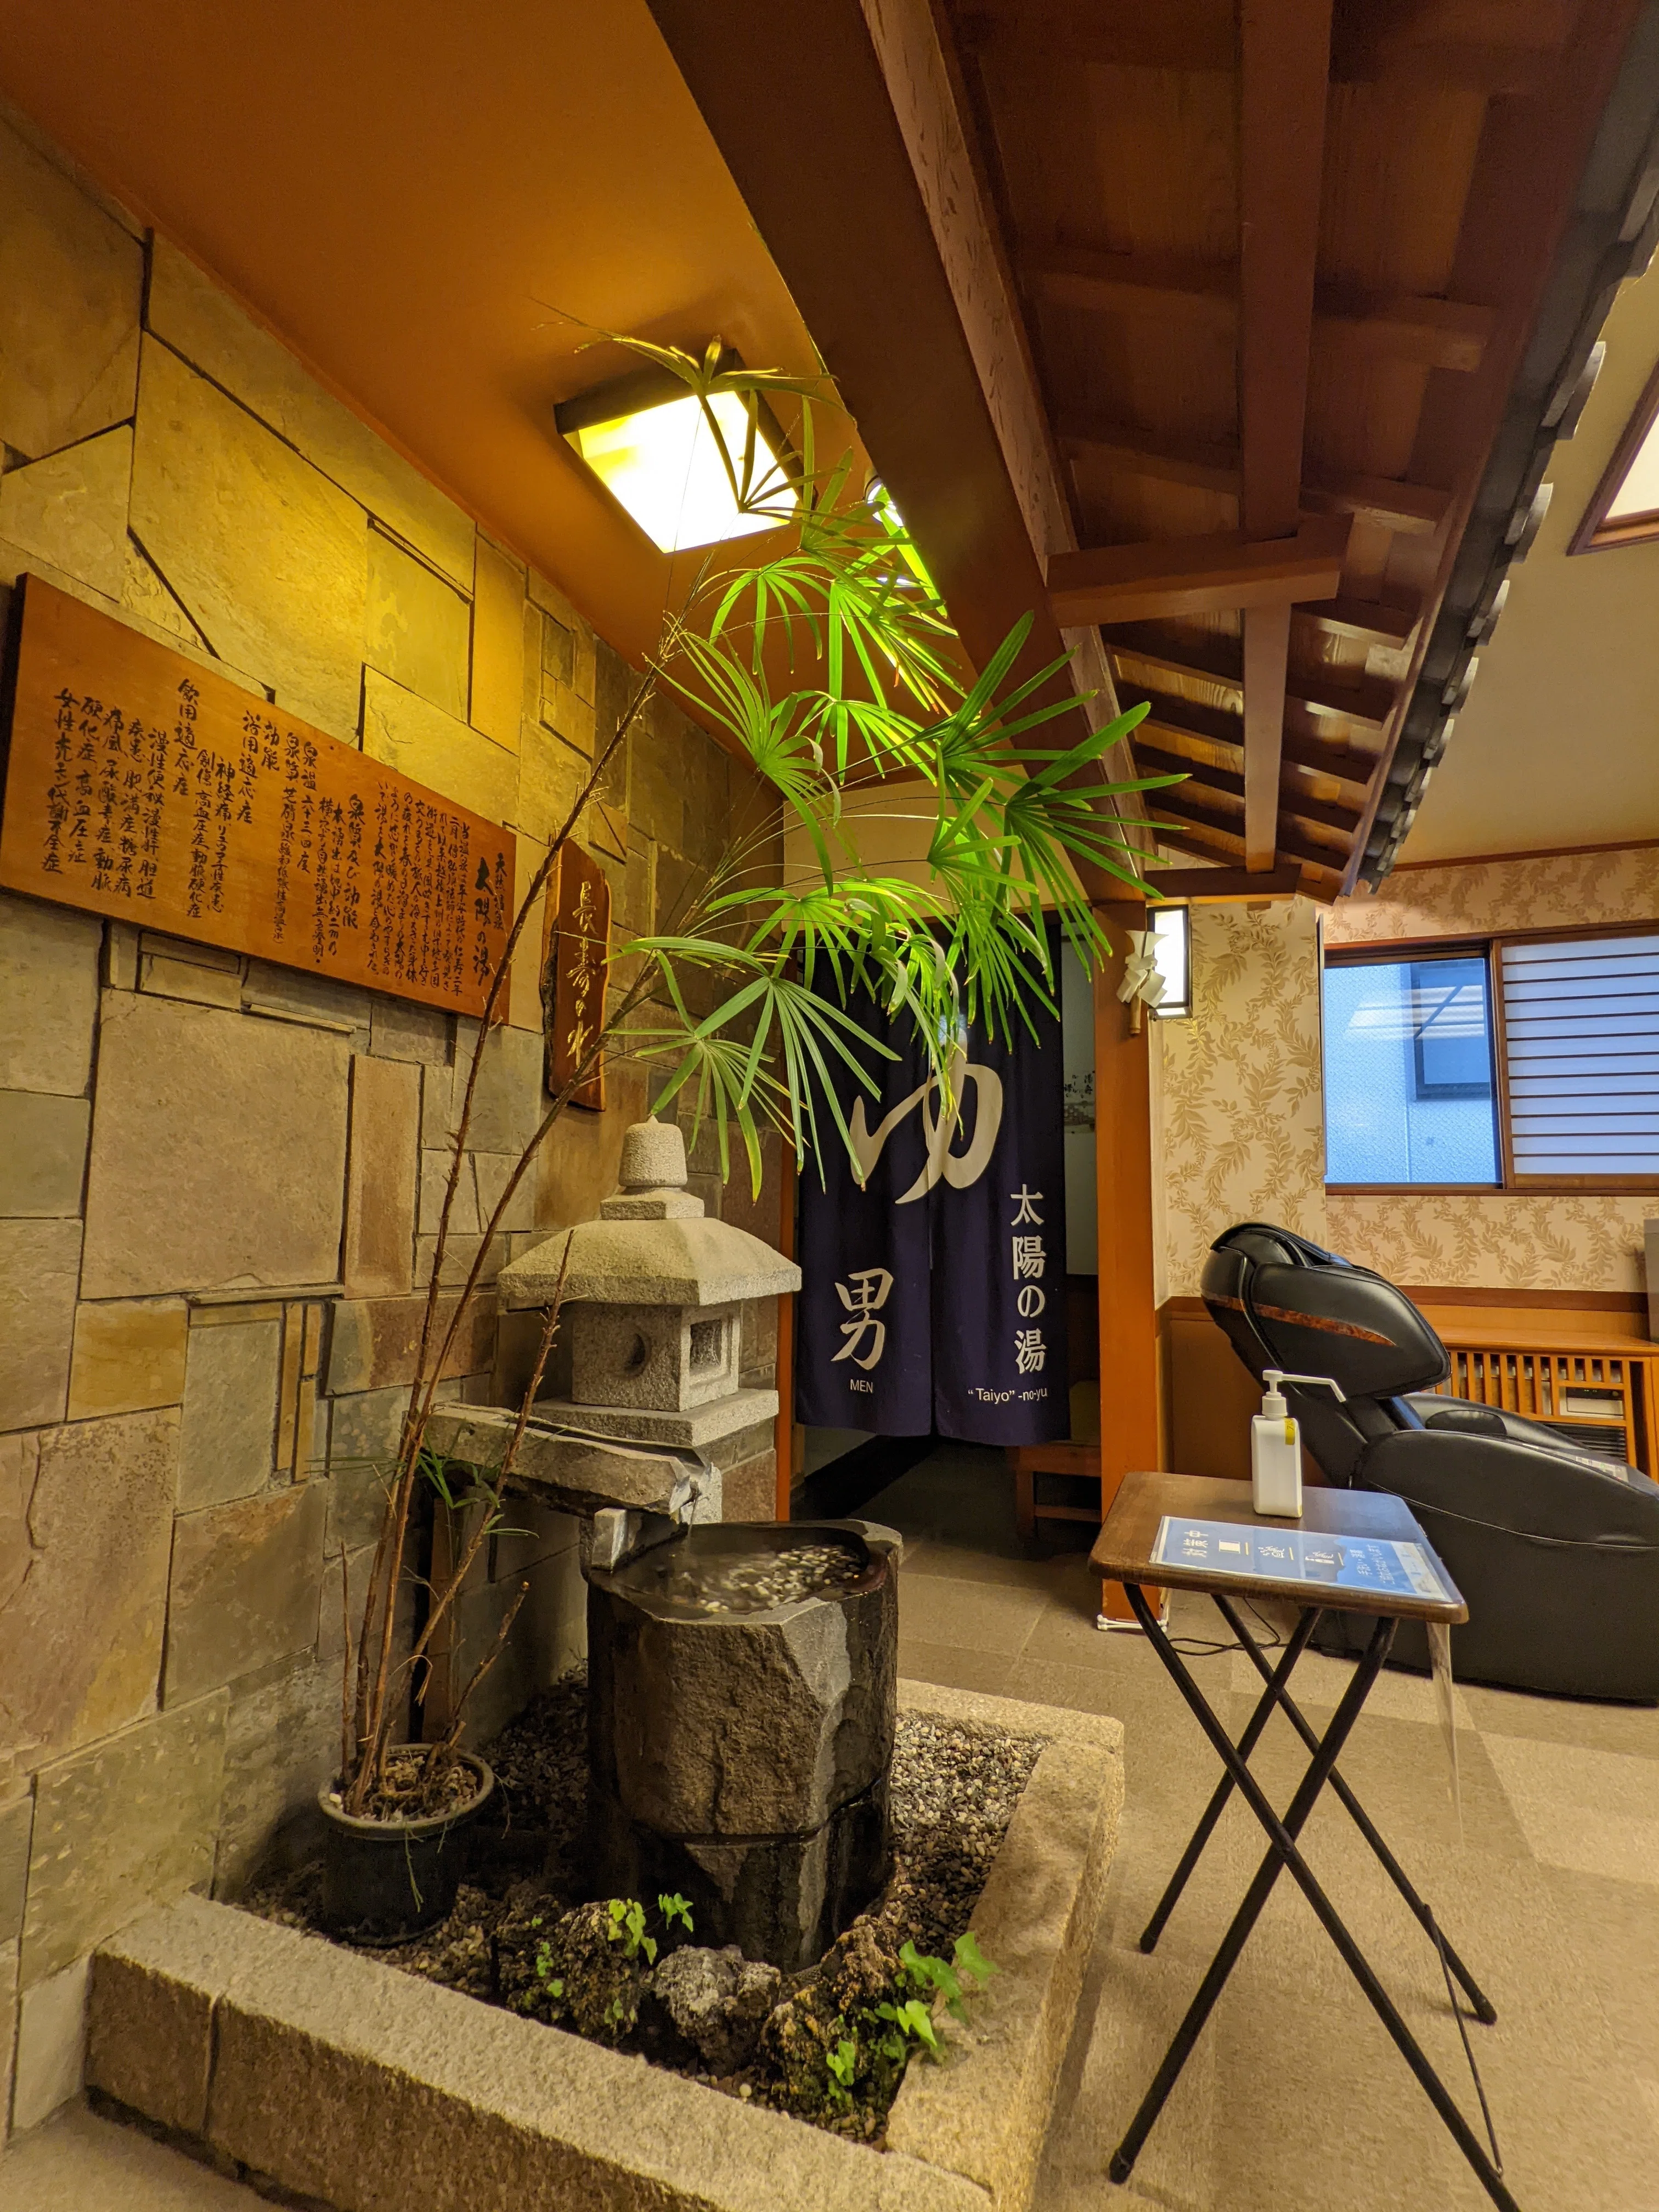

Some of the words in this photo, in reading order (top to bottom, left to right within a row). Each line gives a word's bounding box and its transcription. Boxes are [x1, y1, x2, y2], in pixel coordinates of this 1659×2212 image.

[173, 679, 200, 795] 飲用適応症
[237, 709, 261, 824] 浴用適応症
[261, 720, 280, 771] 効能
[472, 856, 494, 987] 太陽の湯
[494, 853, 507, 930] 天然温泉
[850, 1027, 1003, 1204] ゆ
[831, 1268, 894, 1370] 男
[1011, 1184, 1047, 1374] 太陽の湯
[850, 1379, 874, 1393] MEN
[1182, 1530, 1209, 1558] 対策中
